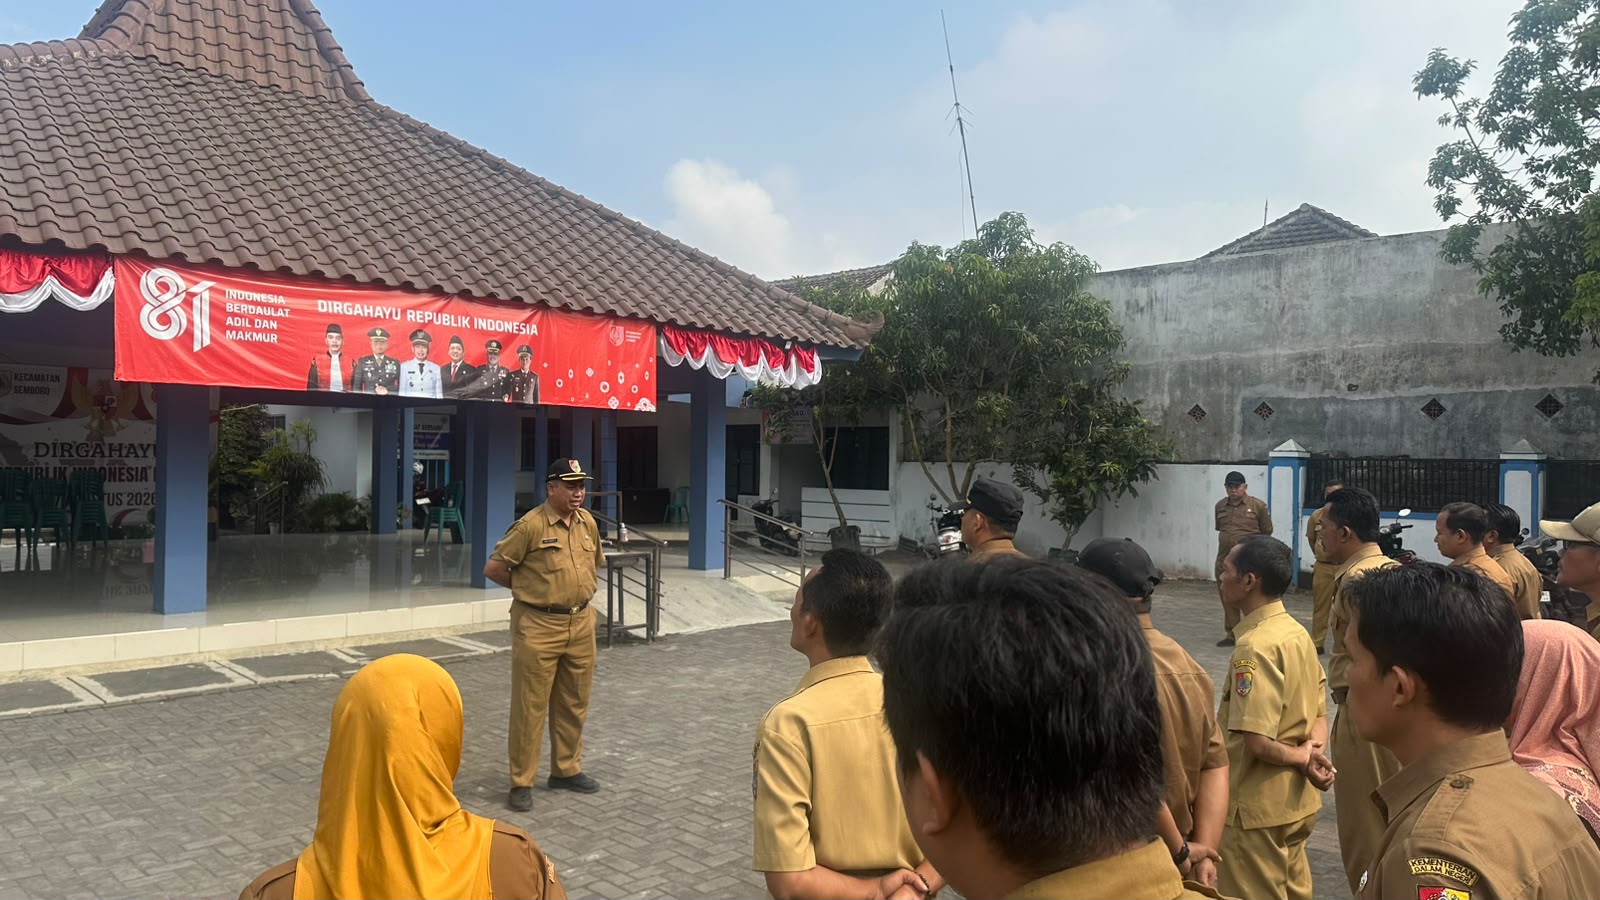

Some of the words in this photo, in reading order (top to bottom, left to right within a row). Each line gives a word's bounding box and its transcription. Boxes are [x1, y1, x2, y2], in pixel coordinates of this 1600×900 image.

[225, 289, 285, 305] INDONESIA
[139, 268, 216, 352] 81
[225, 303, 290, 318] BERDAULAT
[317, 299, 401, 320] DIRGAHAYU
[406, 310, 471, 329] REPUBLIK
[474, 317, 539, 336] INDONESIA
[225, 317, 253, 329] ADIL
[254, 319, 278, 330] DAN
[225, 331, 278, 343] MAKMUR
[14, 372, 60, 383] KECAMATAN
[1411, 858, 1475, 879] KEMENTERIAN
[1414, 865, 1443, 873] DALAM
[1445, 868, 1471, 885] NEGERI
